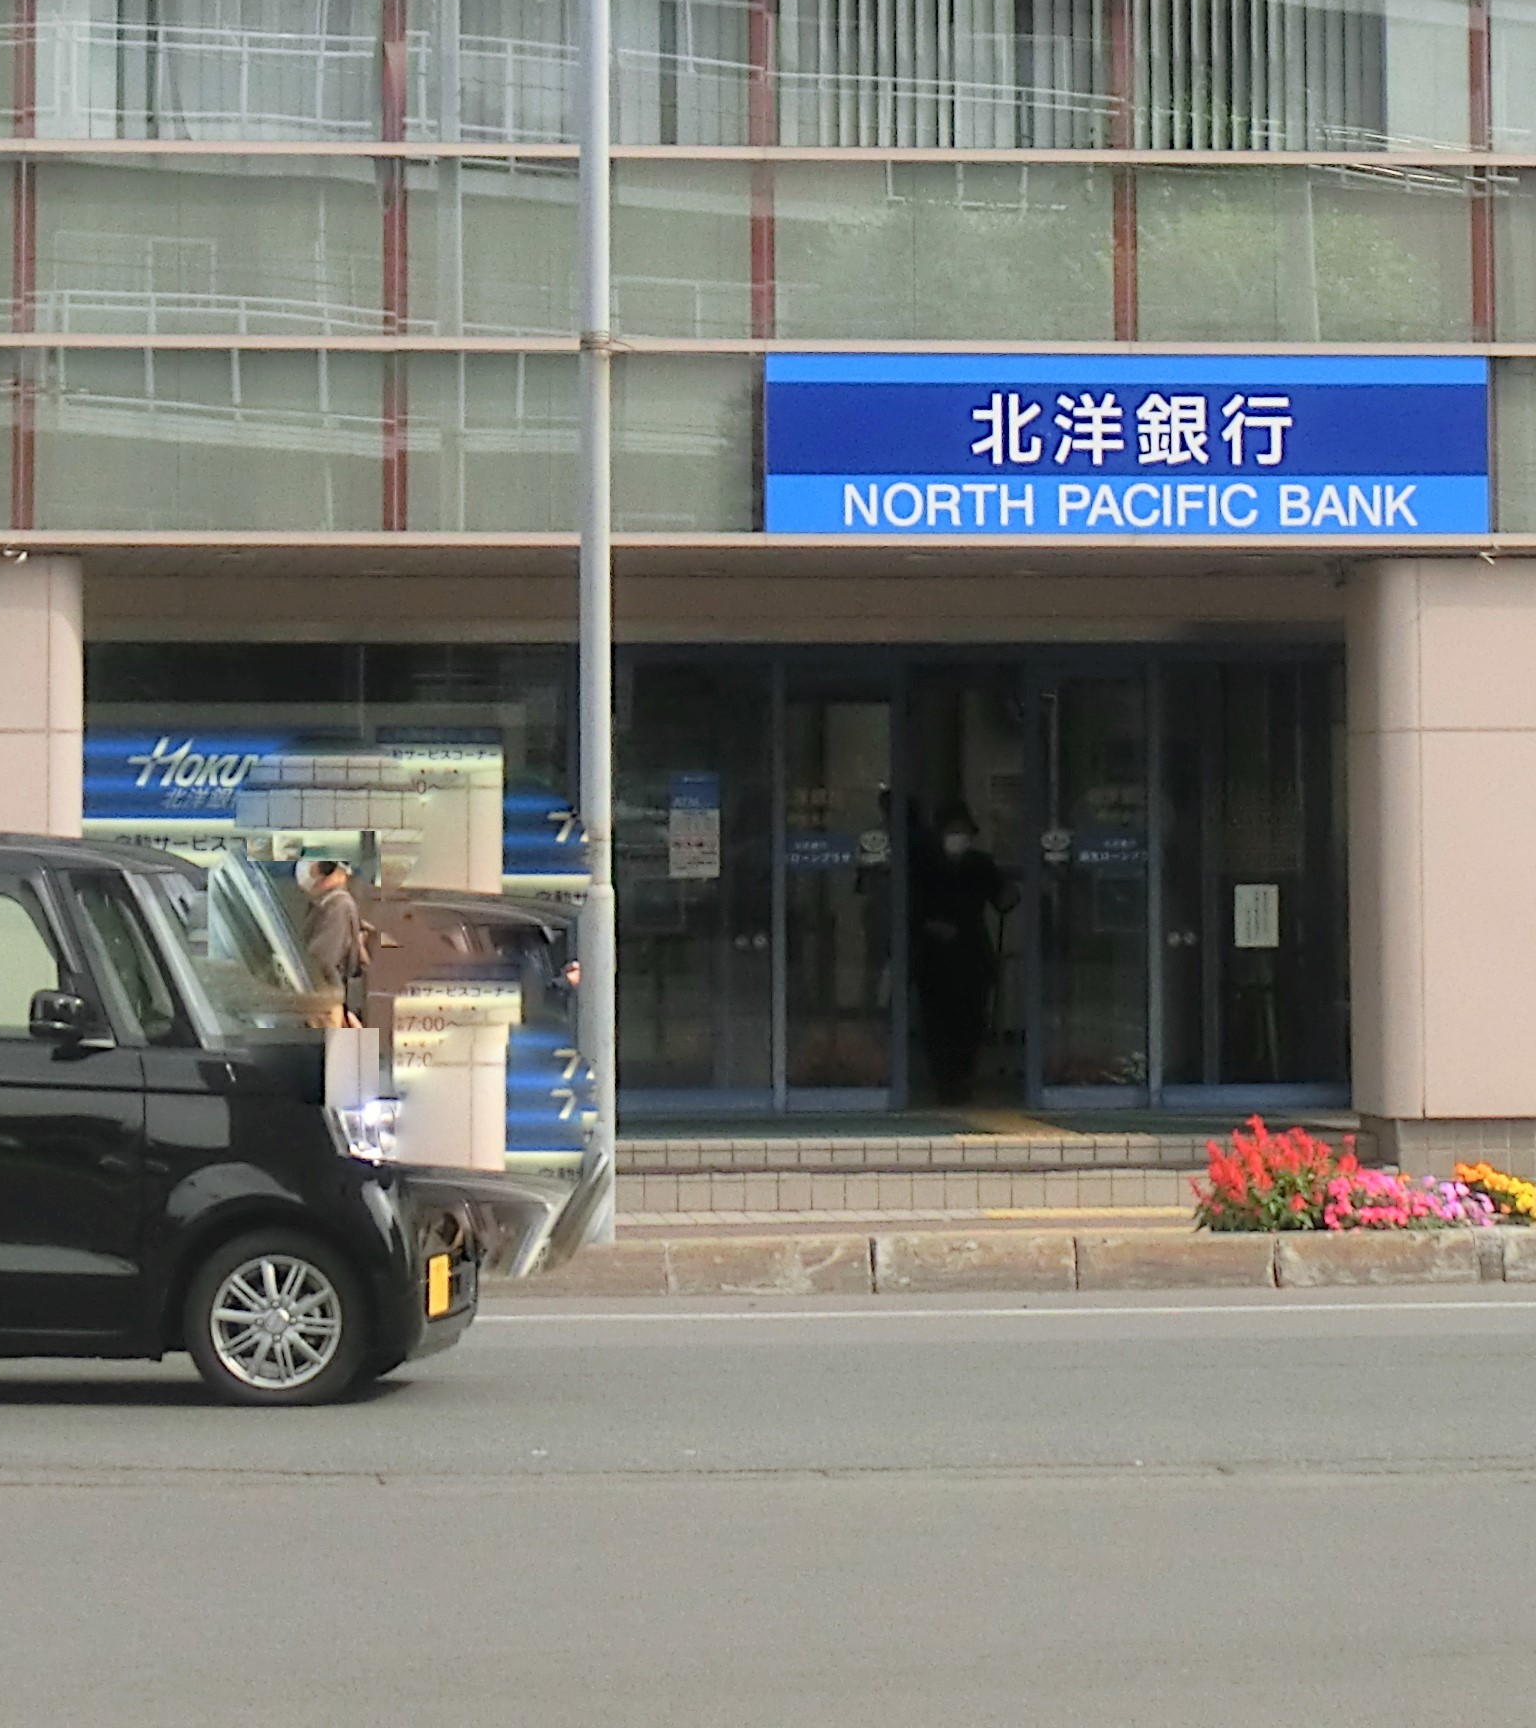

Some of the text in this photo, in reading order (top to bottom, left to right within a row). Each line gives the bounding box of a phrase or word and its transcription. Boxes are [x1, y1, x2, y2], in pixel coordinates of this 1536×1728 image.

[971, 392, 1294, 466] 北洋銀行
[843, 482, 1419, 528] NORTH PACIFIC BANK
